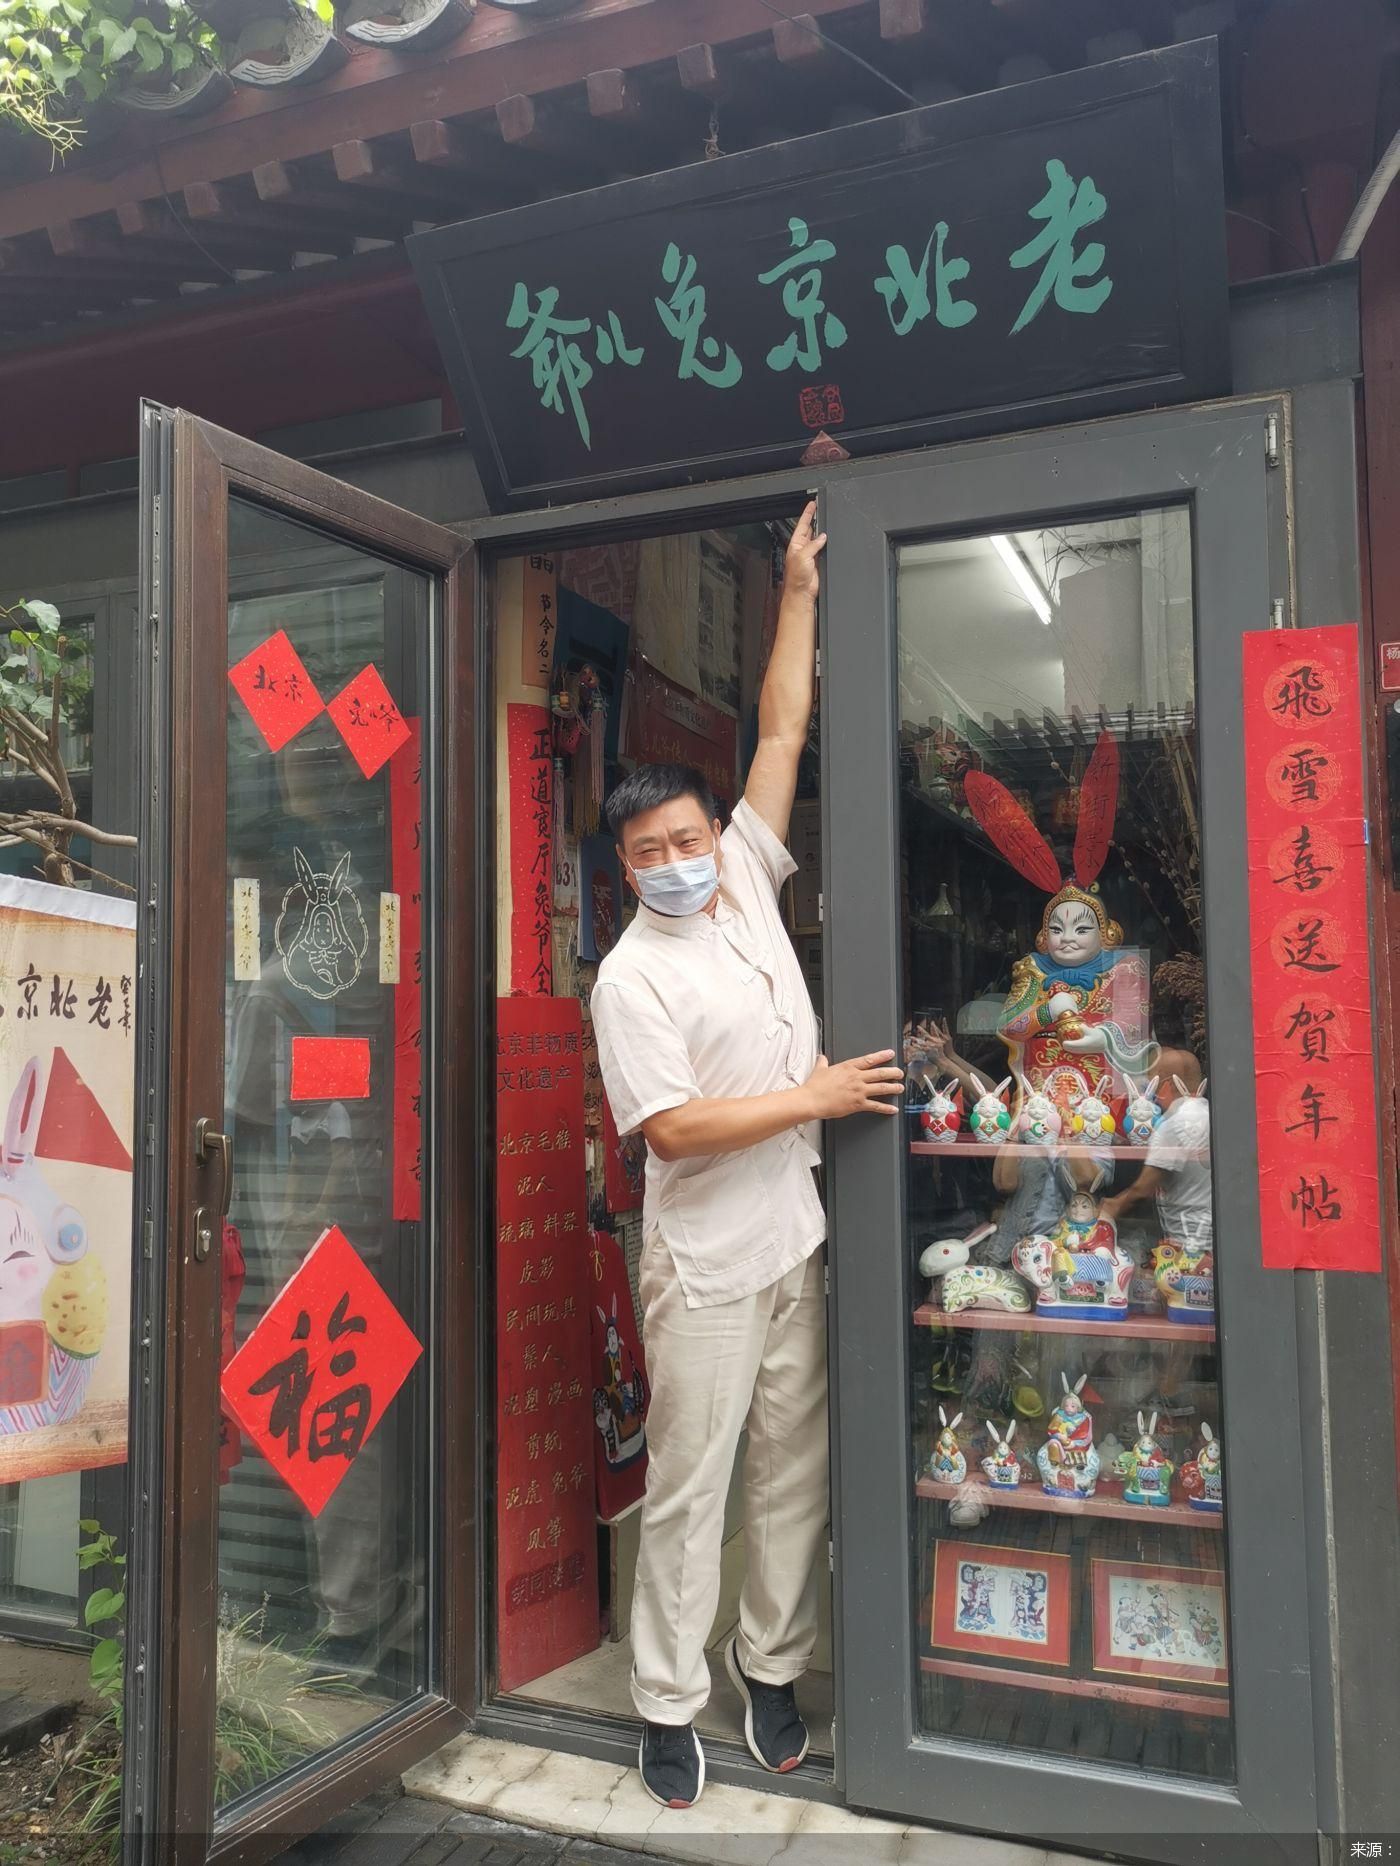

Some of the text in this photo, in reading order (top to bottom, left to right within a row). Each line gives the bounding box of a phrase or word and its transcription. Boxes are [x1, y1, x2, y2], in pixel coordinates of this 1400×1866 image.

[253, 664, 302, 702] 北京
[0, 963, 112, 1030] 老北京
[517, 1176, 555, 1196] 泥人
[506, 1296, 576, 1331] 民间玩具
[247, 1290, 372, 1463] 福
[526, 1430, 562, 1460] 剪纸
